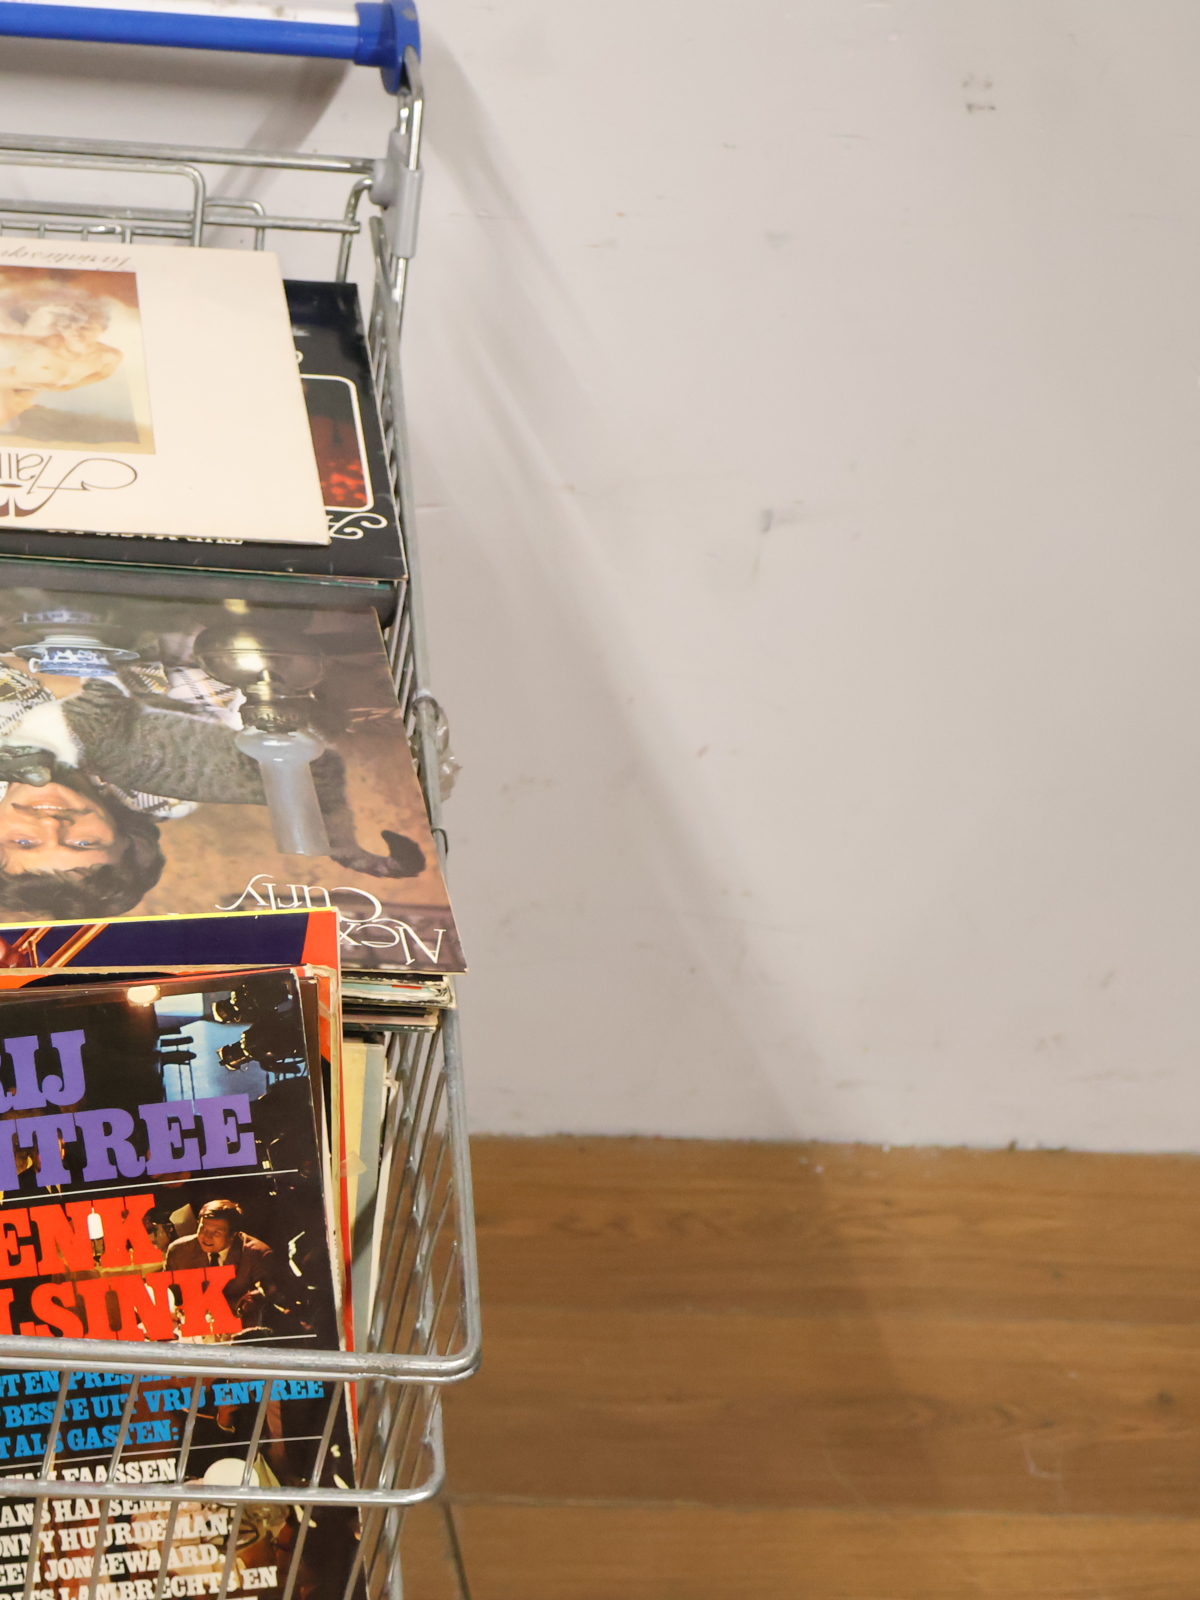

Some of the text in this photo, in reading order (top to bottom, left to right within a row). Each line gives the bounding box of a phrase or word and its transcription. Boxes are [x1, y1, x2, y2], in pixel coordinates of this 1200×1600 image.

[214, 873, 383, 923] Curly
[340, 917, 447, 966] Alex
[23, 1370, 61, 1396] EN
[2, 1397, 89, 1428] BESTE
[240, 1566, 278, 1591] EN
